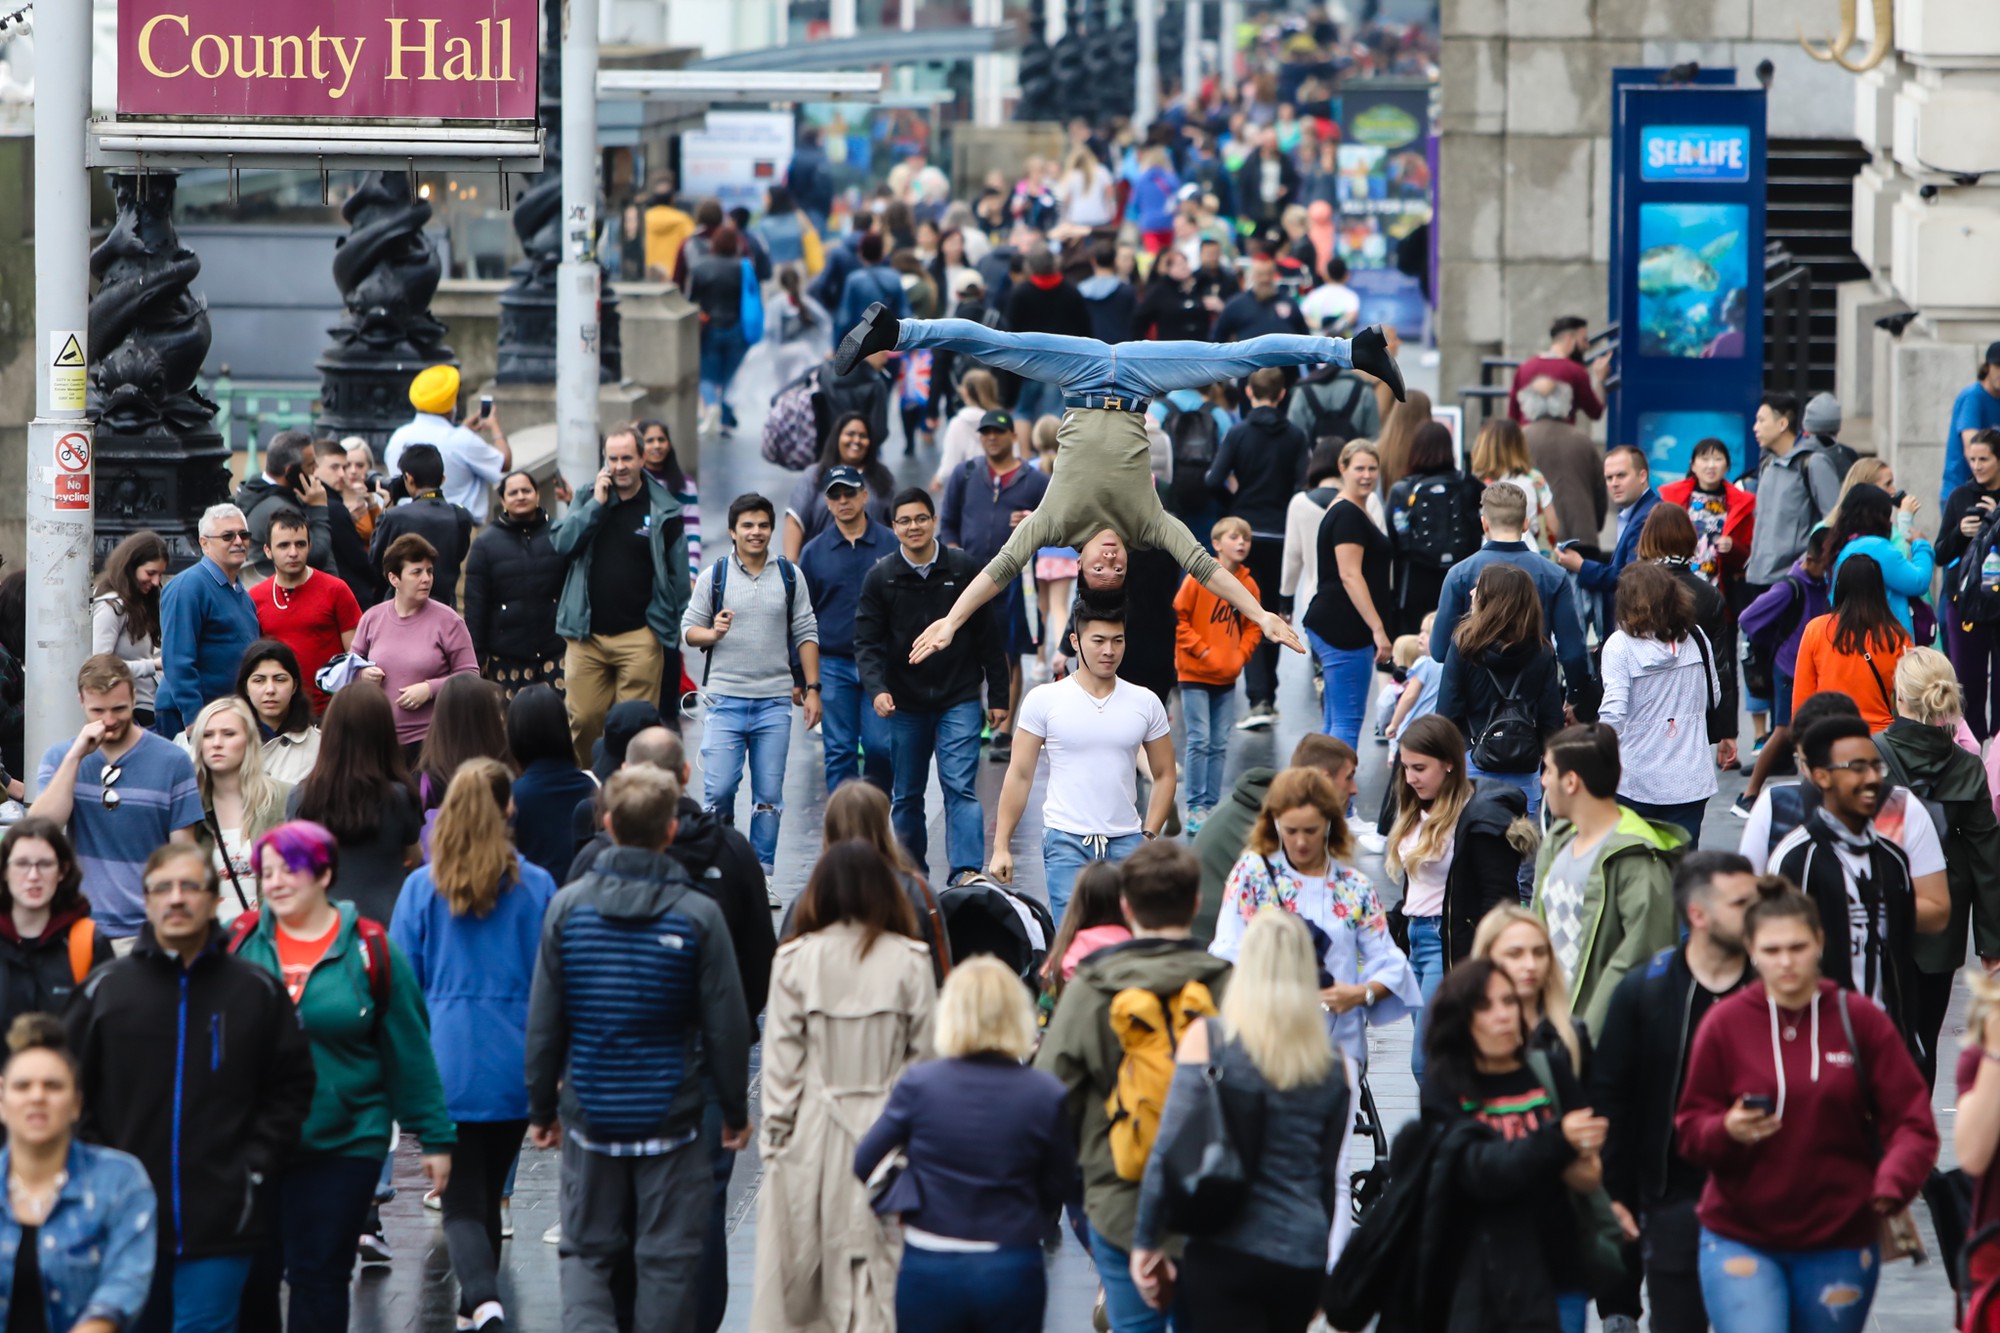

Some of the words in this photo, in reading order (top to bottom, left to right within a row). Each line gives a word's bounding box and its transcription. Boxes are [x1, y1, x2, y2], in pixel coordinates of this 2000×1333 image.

[138, 14, 366, 98] County
[384, 17, 516, 81] Hall
[1648, 137, 1694, 168] SEA
[67, 480, 81, 490] No
[56, 492, 90, 503] cycling
